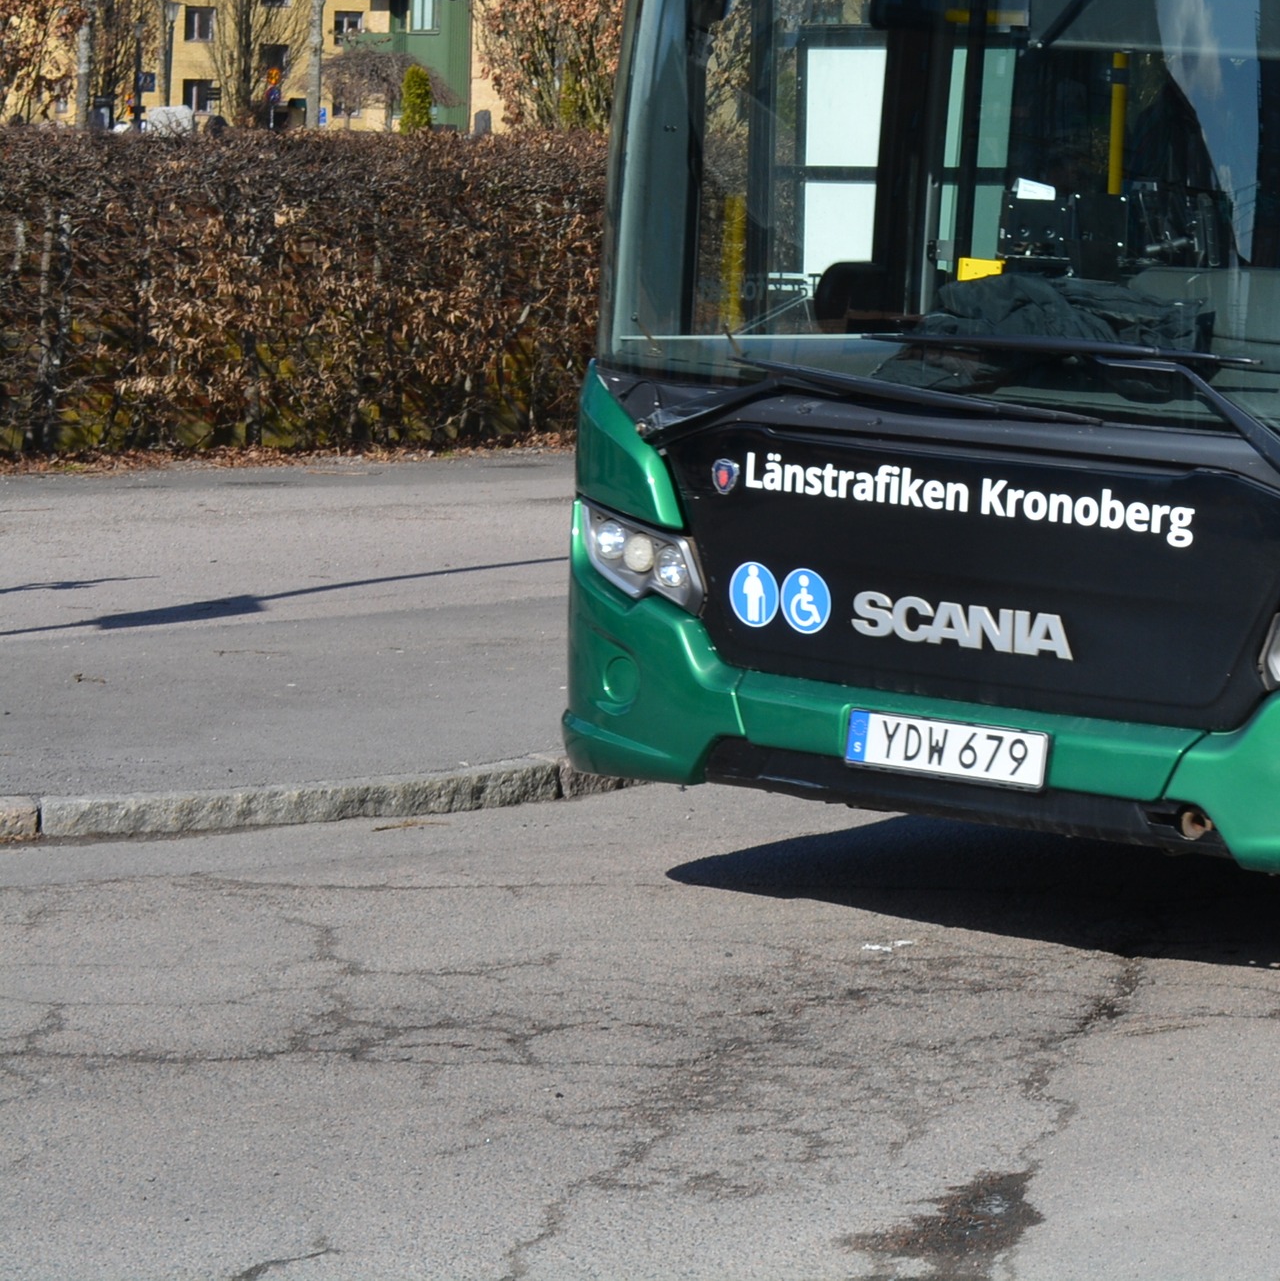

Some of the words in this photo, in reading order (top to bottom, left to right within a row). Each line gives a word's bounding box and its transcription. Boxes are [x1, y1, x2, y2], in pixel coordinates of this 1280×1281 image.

[745, 451, 970, 513] Länstrafiken
[980, 477, 1196, 548] Kronoberg
[850, 590, 1074, 661] SCANIA
[853, 741, 862, 753] S
[882, 719, 949, 766] YDW
[957, 732, 1029, 777] 679
